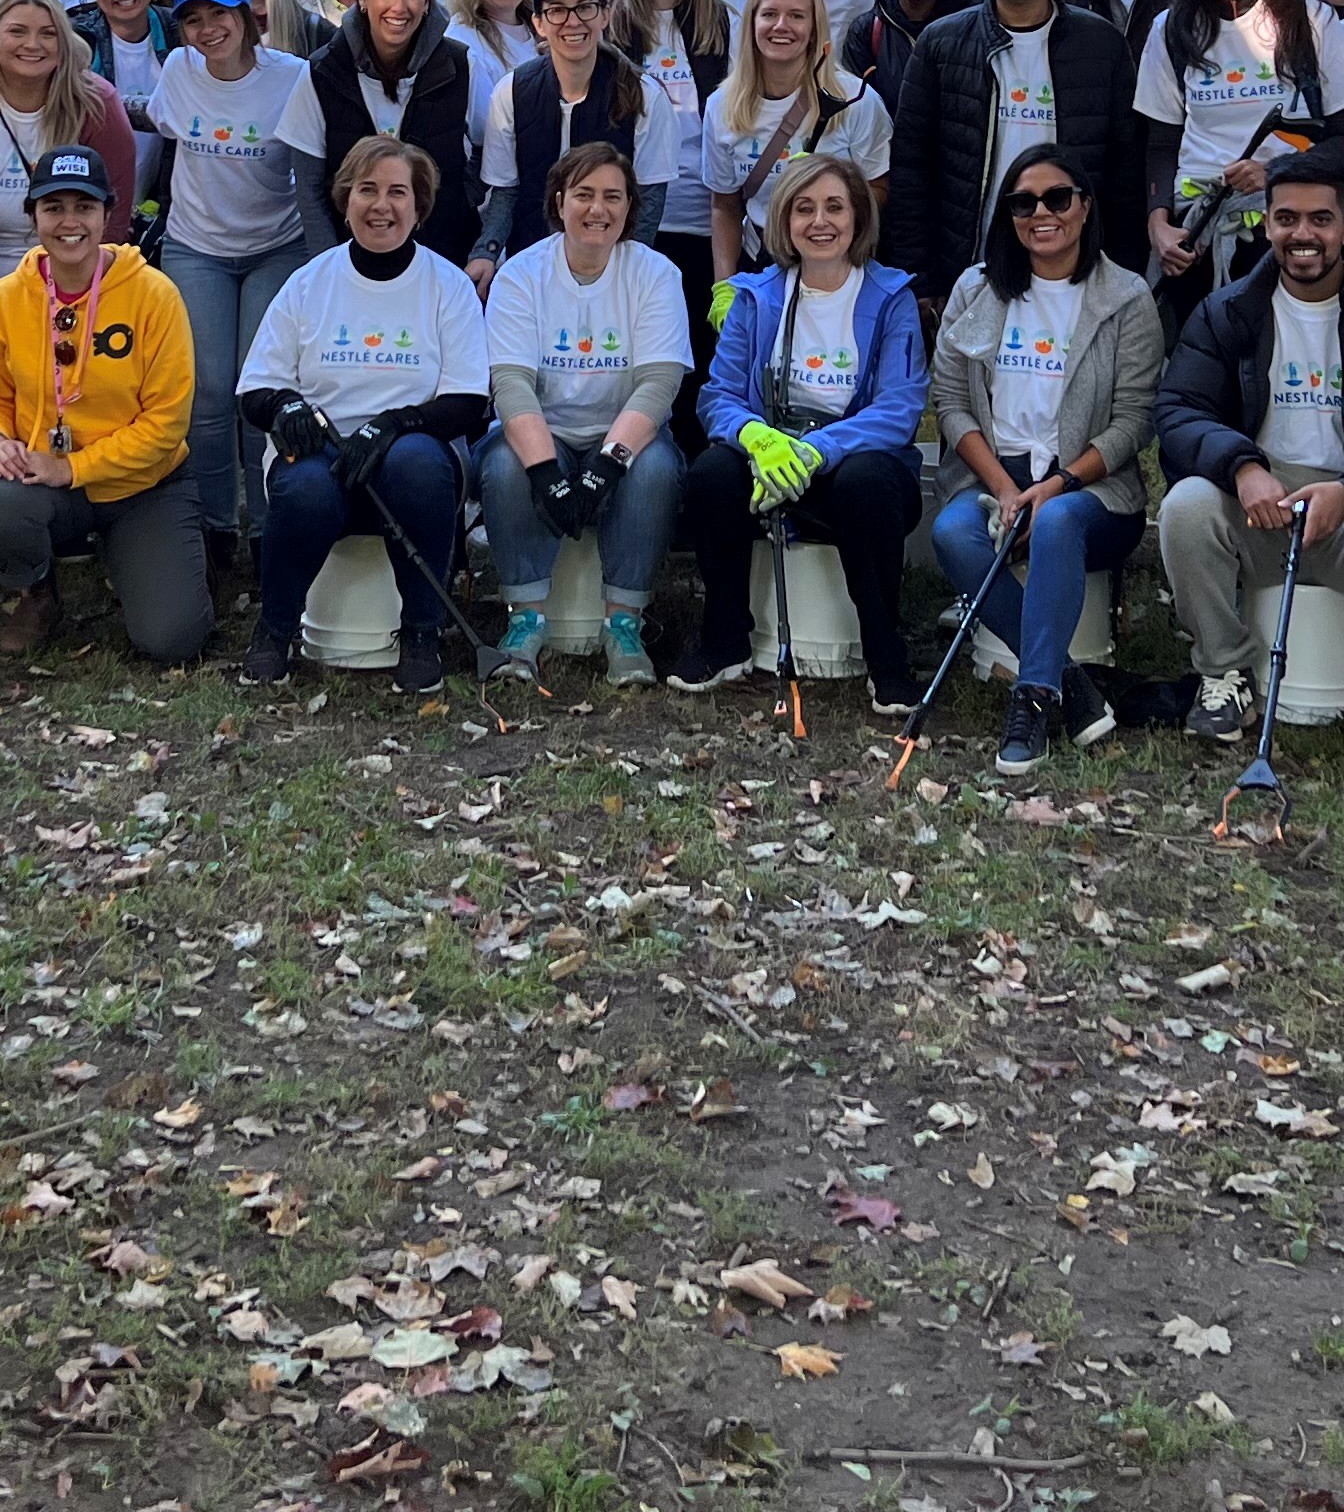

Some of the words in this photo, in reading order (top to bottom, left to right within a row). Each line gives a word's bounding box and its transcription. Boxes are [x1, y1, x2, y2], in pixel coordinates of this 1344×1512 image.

[1190, 85, 1235, 101] NESTLÉ
[1239, 82, 1285, 98] CARES
[999, 104, 1017, 118] TLÉ
[1021, 107, 1056, 121] CARE
[225, 145, 267, 158] CARES
[739, 161, 782, 175] NELÉ
[320, 349, 370, 364] NESTLÉ
[375, 351, 421, 366] CARES
[541, 354, 587, 369] NESTLÉ
[587, 356, 629, 369] CARES
[792, 369, 813, 384] TLÉ
[1274, 391, 1317, 405] NESTL
[1317, 393, 1343, 408] CAR
